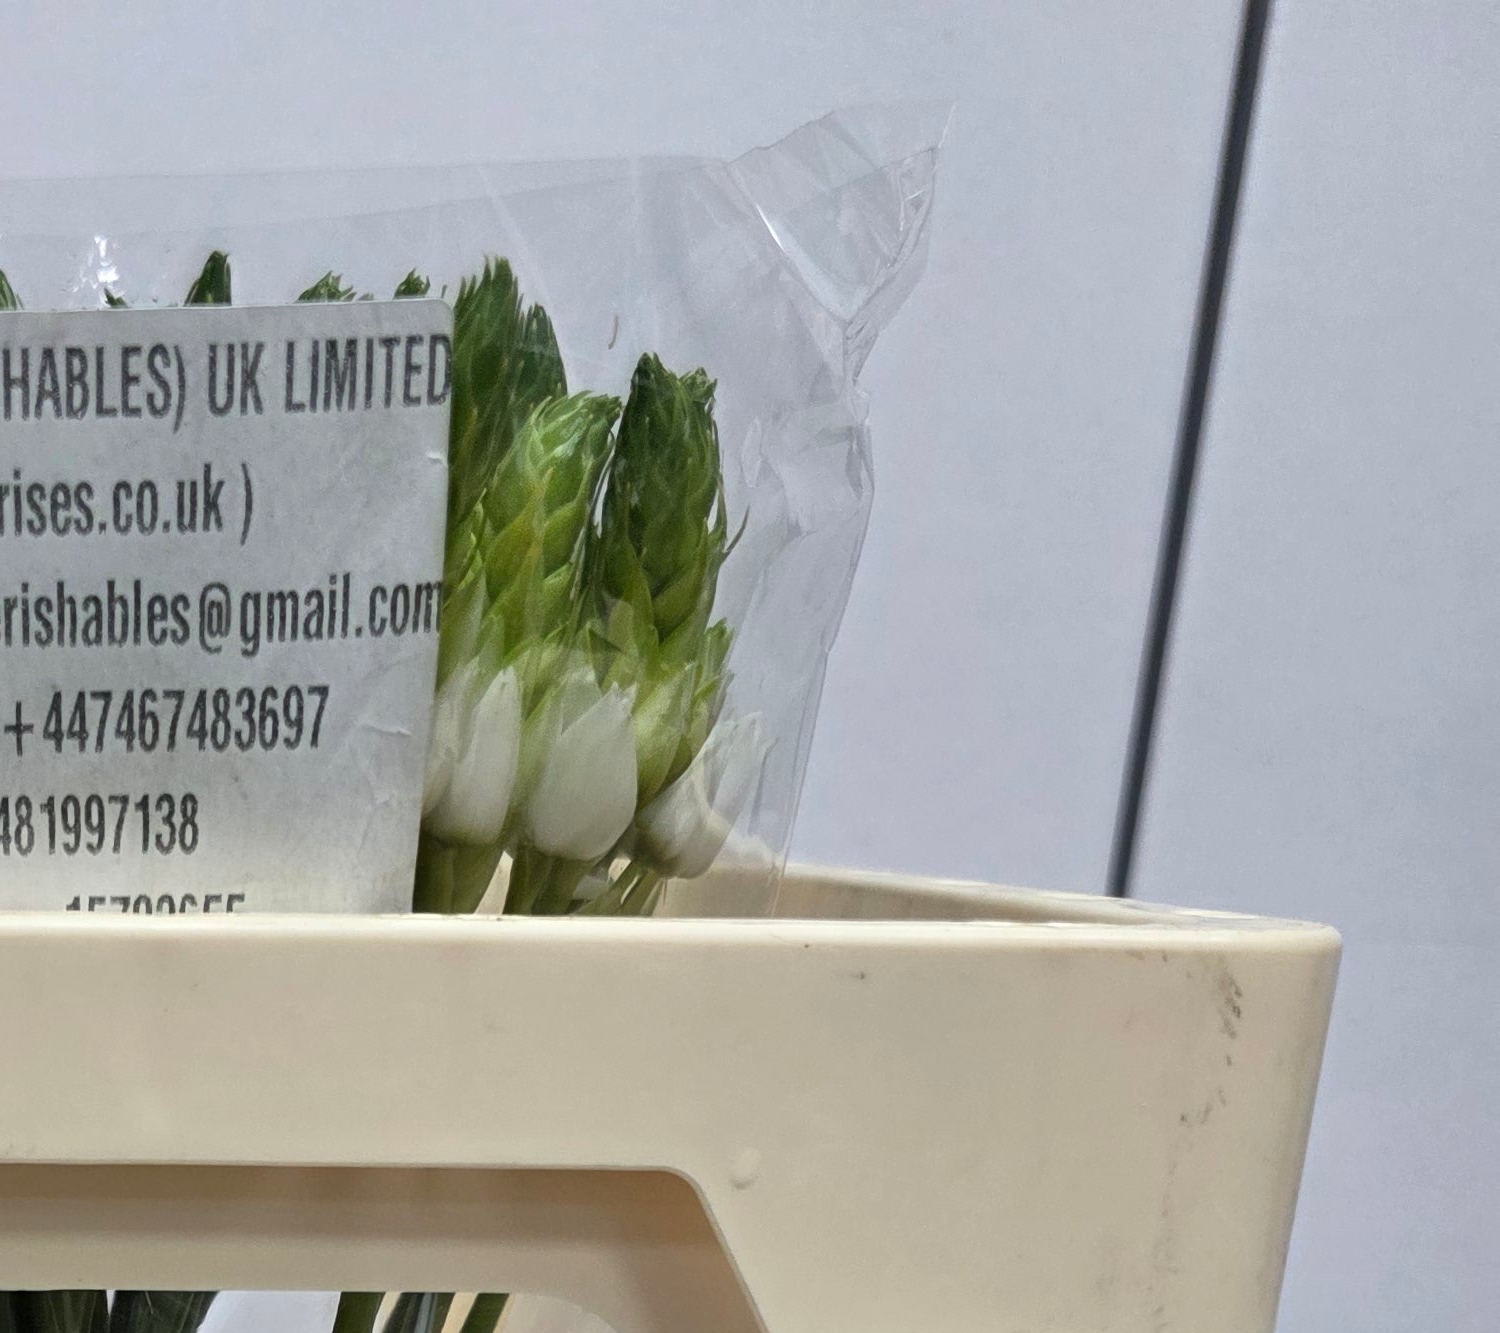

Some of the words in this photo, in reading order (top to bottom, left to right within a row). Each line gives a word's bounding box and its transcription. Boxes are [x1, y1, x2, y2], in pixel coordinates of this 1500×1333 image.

[207, 341, 265, 415] UK
[284, 332, 451, 414] LIMITED
[3, 684, 330, 757] +447467483697
